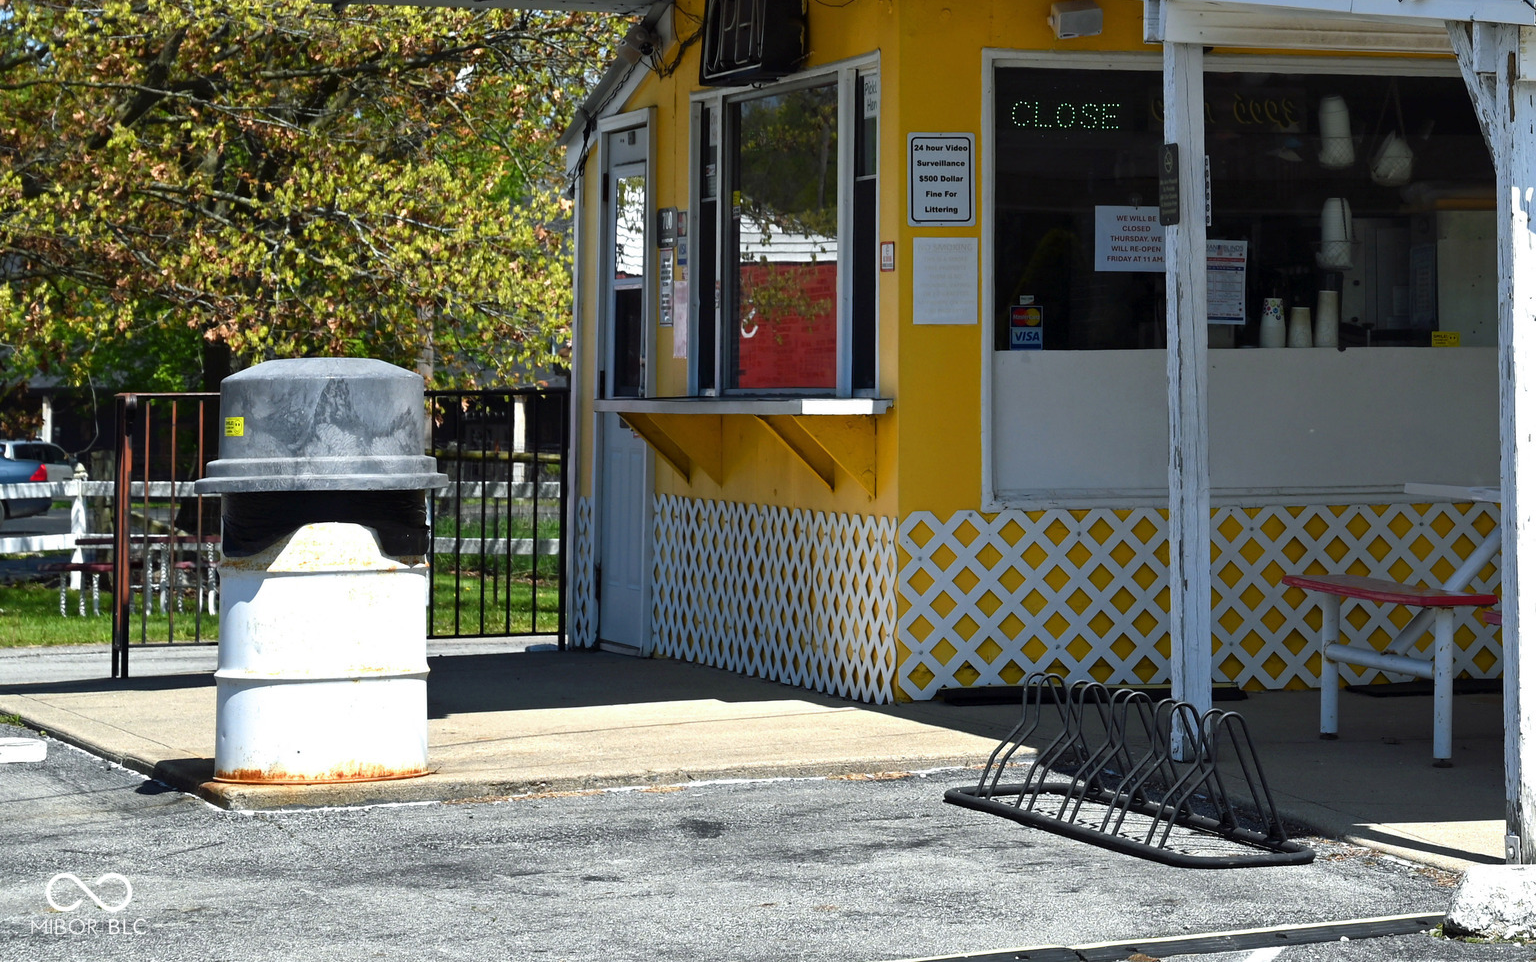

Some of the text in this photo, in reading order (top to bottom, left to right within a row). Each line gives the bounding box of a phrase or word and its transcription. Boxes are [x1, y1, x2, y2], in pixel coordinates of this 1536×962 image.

[1011, 100, 1121, 130] CLOSE
[925, 206, 958, 214] Littering
[1014, 331, 1040, 341] VISA
